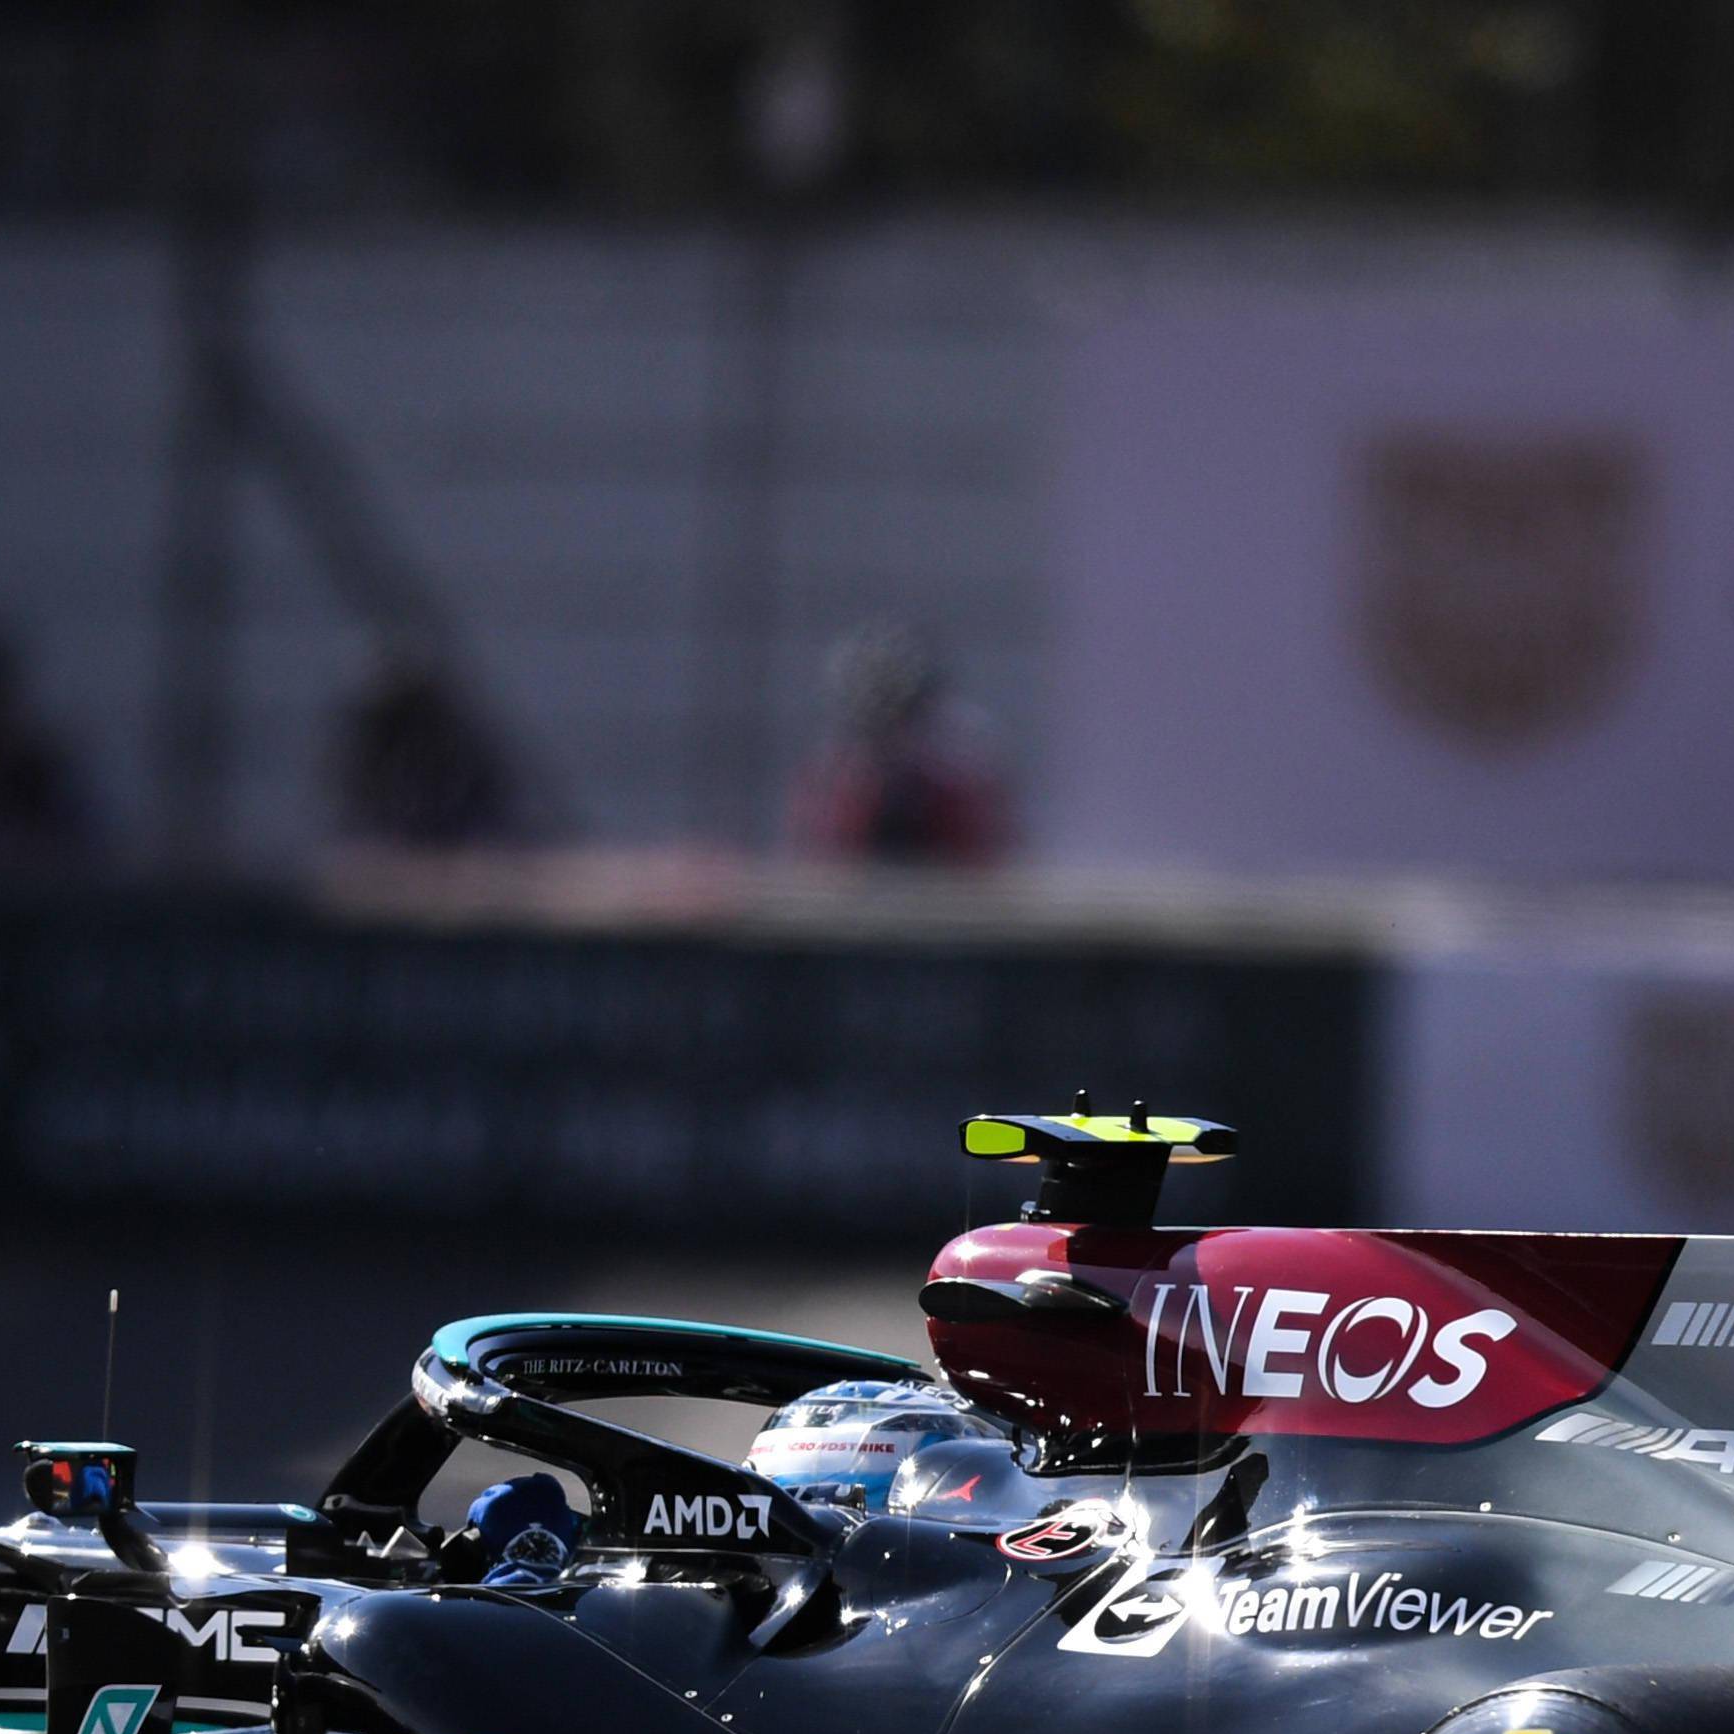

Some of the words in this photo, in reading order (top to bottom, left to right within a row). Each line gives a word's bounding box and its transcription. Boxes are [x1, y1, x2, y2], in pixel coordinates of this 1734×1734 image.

[522, 1359, 545, 1375] THE
[1143, 1283, 1518, 1409] INEOS
[643, 1493, 734, 1537] AMD
[1218, 1571, 1554, 1641] TeamViewer
